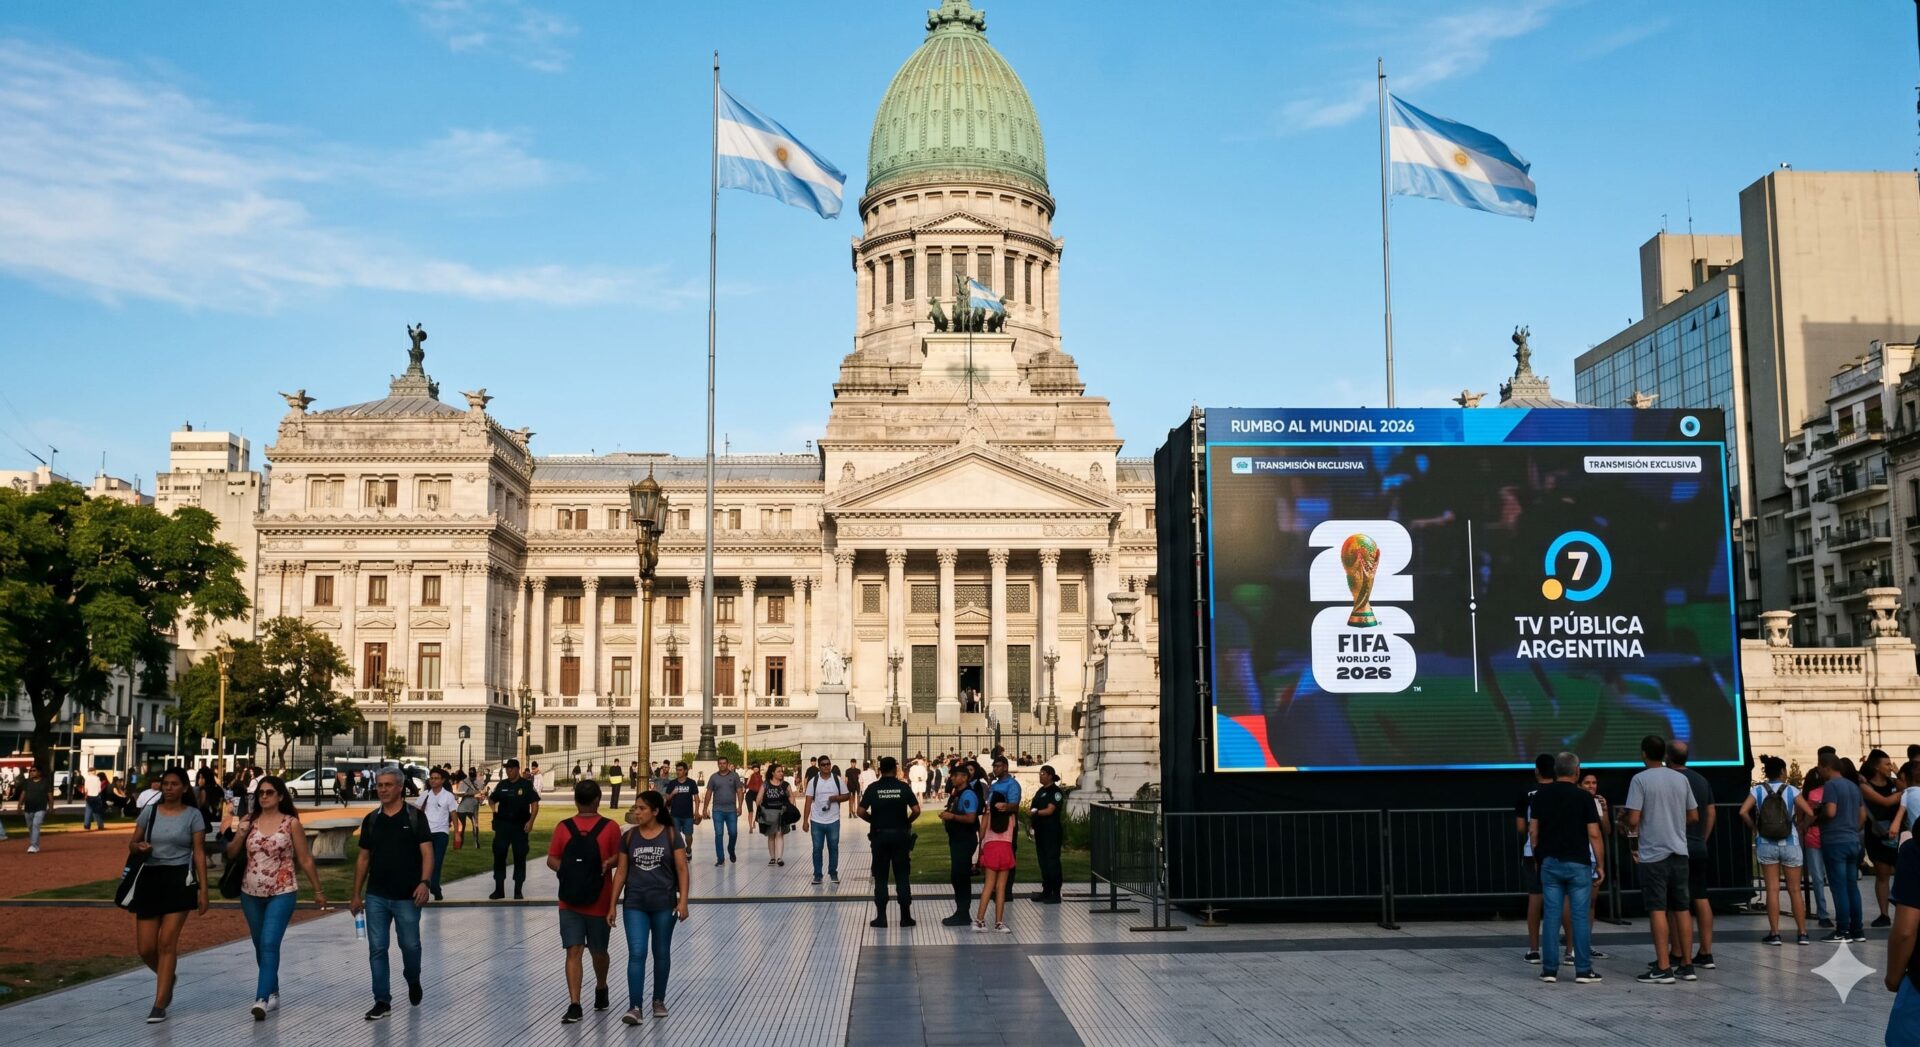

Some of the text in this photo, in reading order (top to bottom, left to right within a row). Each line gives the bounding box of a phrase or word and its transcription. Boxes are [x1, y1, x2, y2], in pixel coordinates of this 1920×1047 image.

[1231, 420, 1415, 432] RUMBO AL MUNDIAL 2026
[1255, 459, 1315, 470] TRANSMISIÓN
[1589, 460, 1697, 469] TRANSMISIÓN EXCLUSIVA
[1567, 551, 1589, 581] 7
[1515, 611, 1644, 635] TV PÚBLICA
[1338, 634, 1389, 653] FIFA
[1516, 639, 1645, 659] ARGENTINA
[1337, 655, 1391, 663] WORLD CUP
[1336, 667, 1392, 680] 2026
